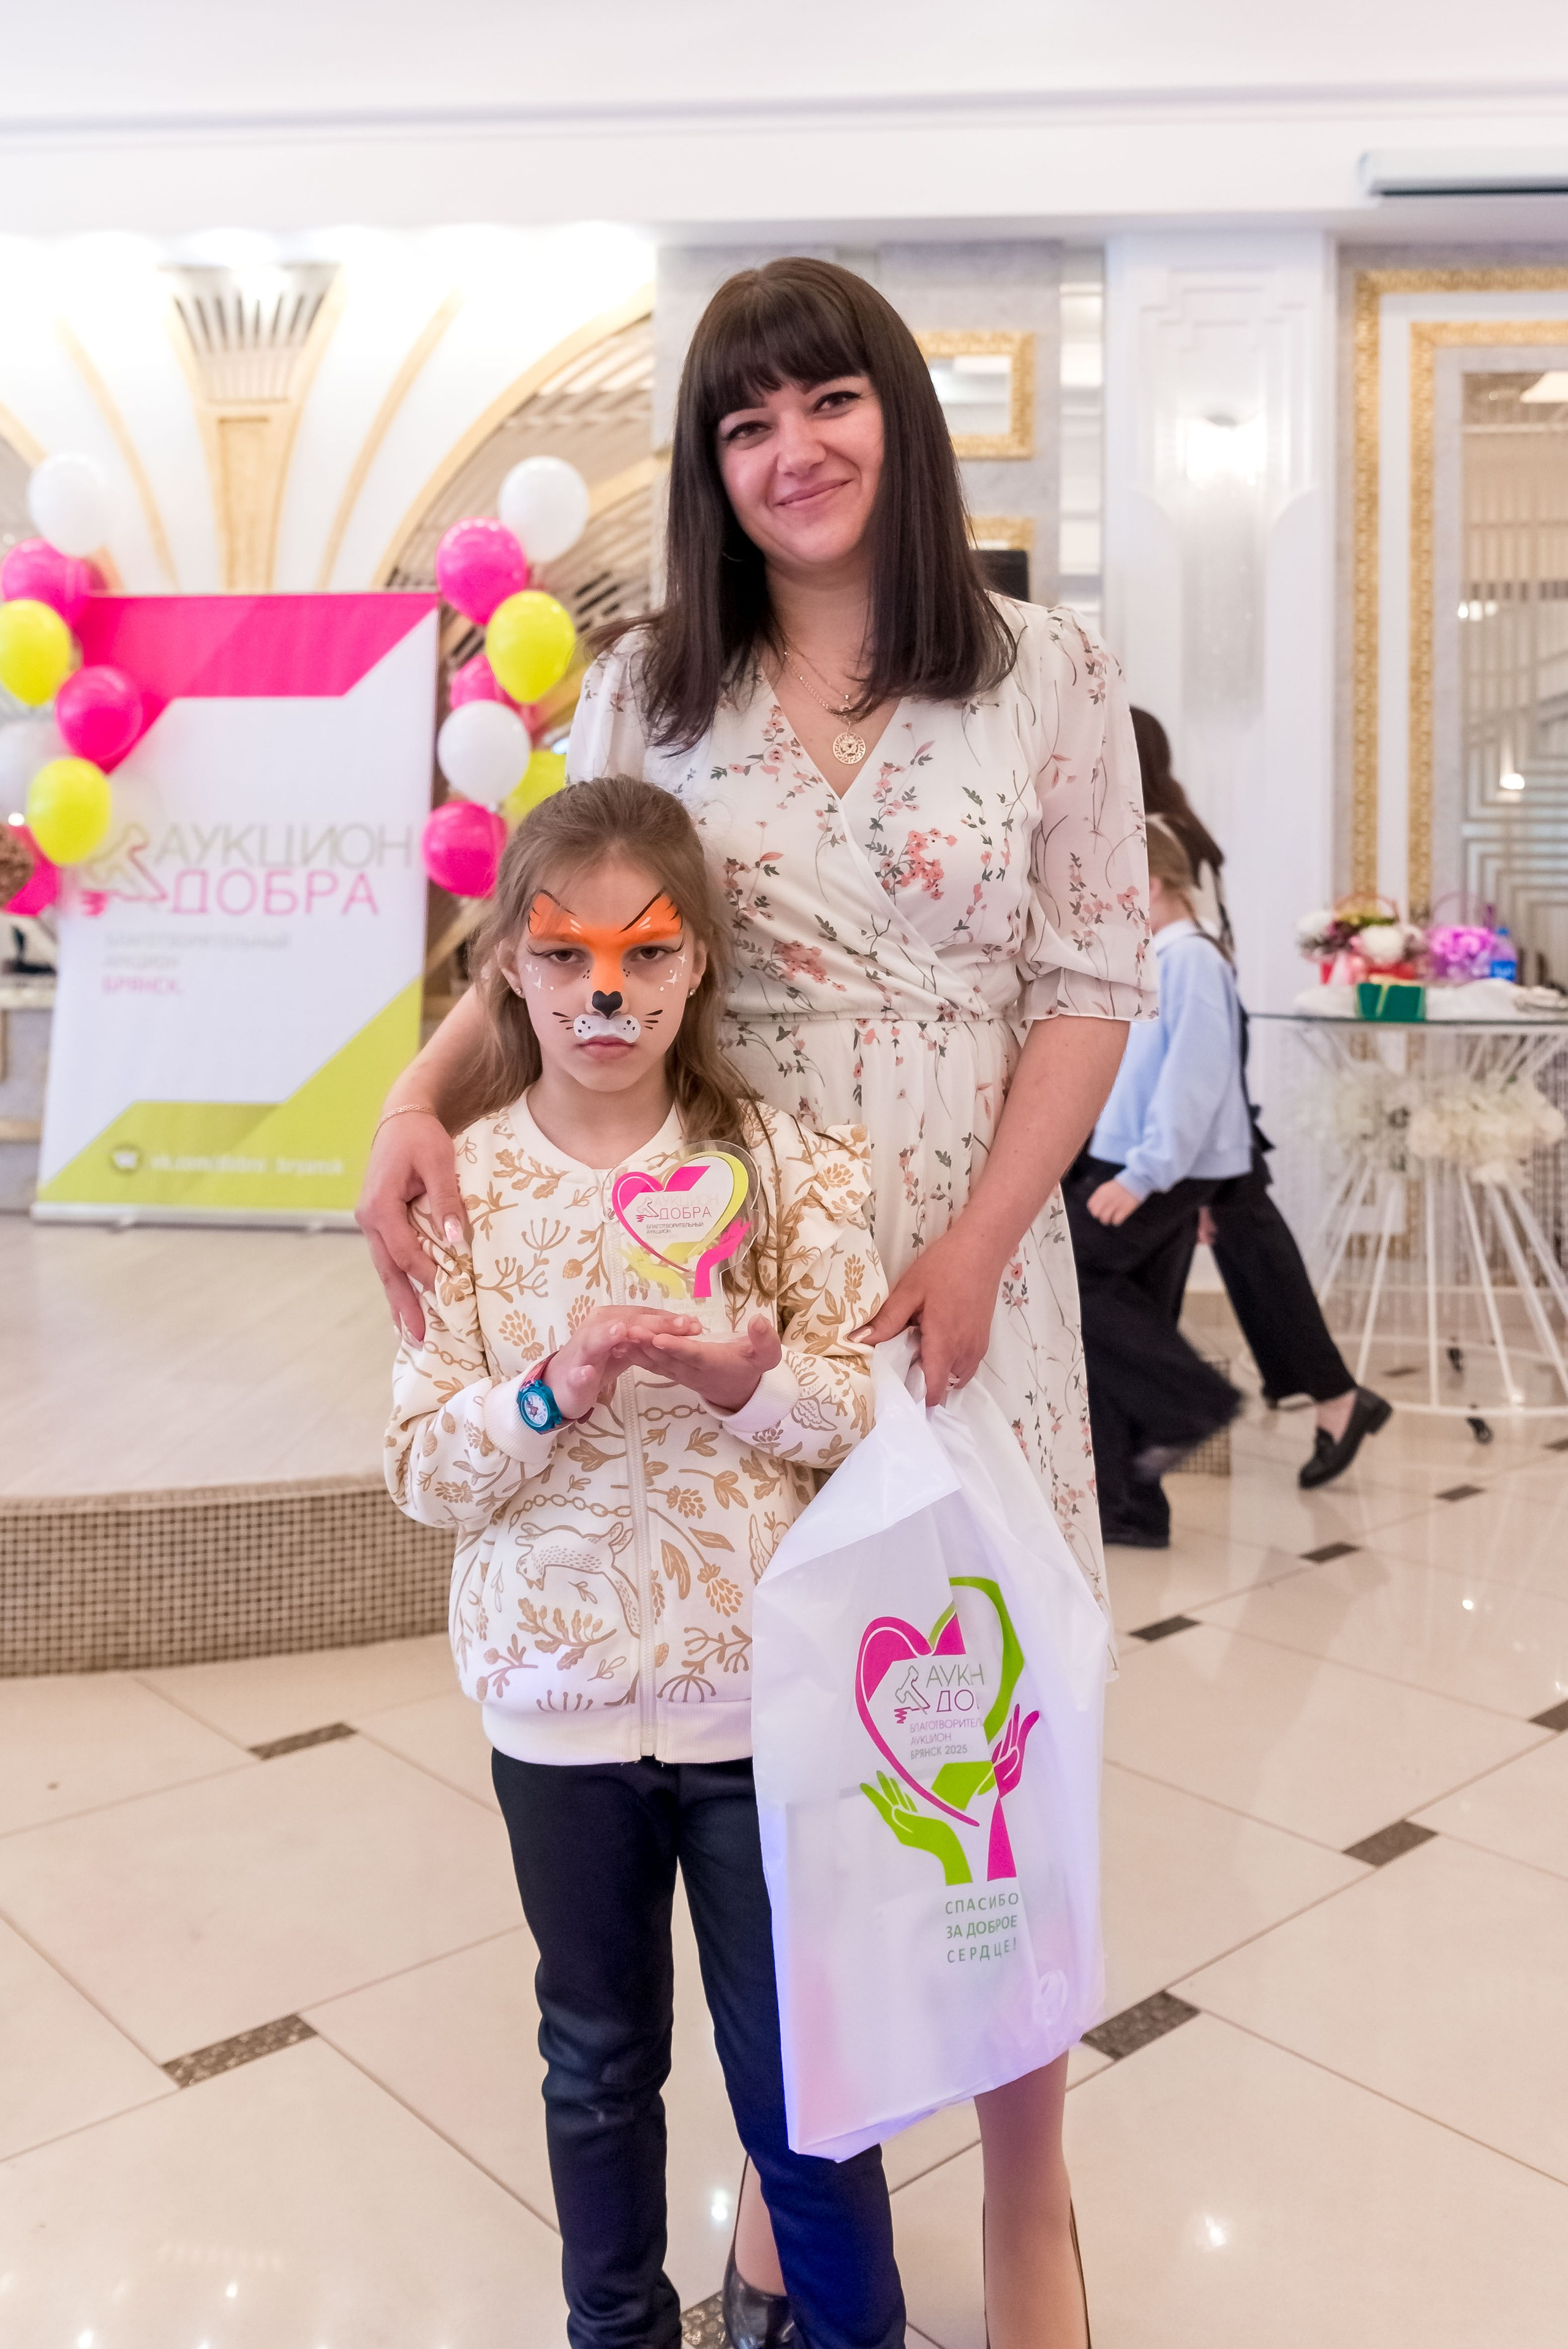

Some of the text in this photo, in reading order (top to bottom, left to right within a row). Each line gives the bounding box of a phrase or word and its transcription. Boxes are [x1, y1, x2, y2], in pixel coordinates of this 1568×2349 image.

[154, 823, 414, 870] АУКЦИОН
[170, 869, 380, 916] ДОБРА
[654, 1194, 718, 1207] АУКЦИОН
[659, 1206, 712, 1220] ДОБРА
[936, 1689, 979, 1713] ДО
[911, 1732, 952, 1746] АУКЦИОН
[911, 1744, 968, 1760] БРЯНСК 2025
[945, 1892, 1019, 1915] СПАСИБО
[946, 1915, 1018, 1939] ЗА ДОБРОЕ
[947, 1936, 1017, 1964] СЕРДЦЕ!
